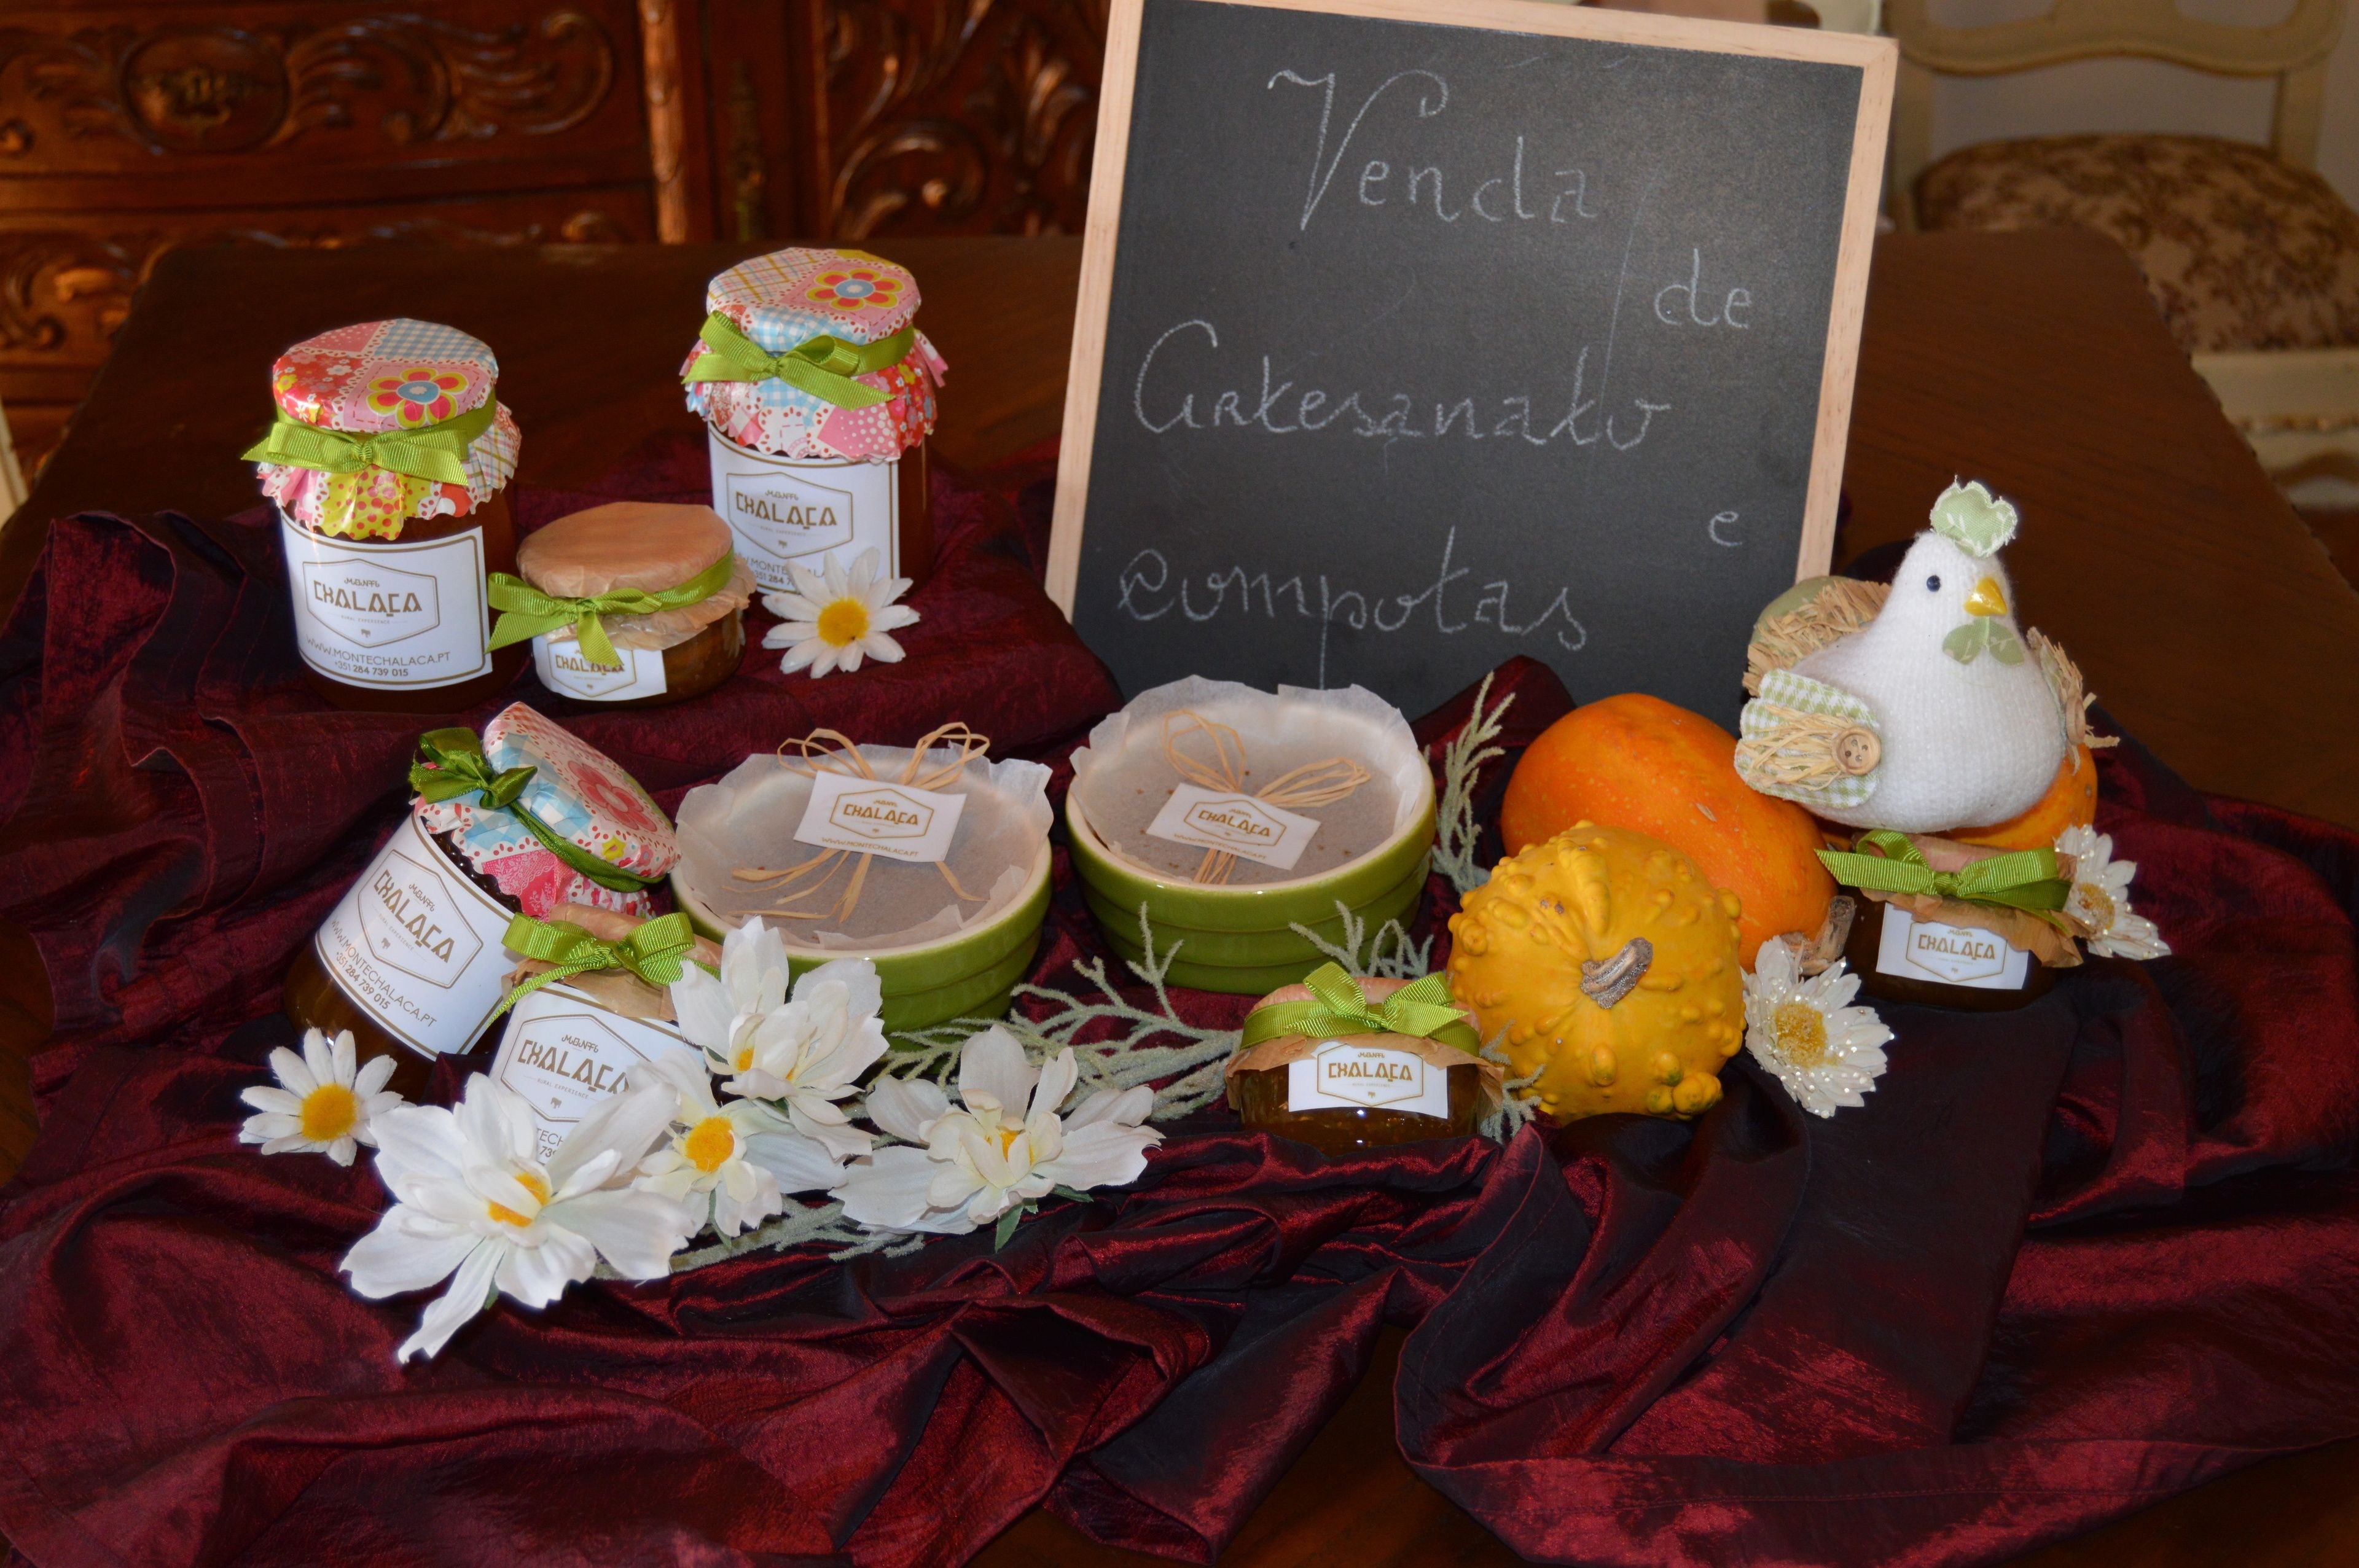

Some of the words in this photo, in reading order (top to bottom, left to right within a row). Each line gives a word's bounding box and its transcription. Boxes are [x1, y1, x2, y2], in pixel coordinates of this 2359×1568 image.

[1267, 68, 1597, 232] Venda
[1653, 247, 1753, 330] de
[754, 569, 767, 580] 351
[768, 574, 784, 584] 284
[353, 664, 370, 674] 284
[372, 667, 389, 676] 739
[391, 668, 409, 677] 015
[345, 964, 361, 982] 284
[358, 978, 375, 995] 739
[374, 993, 391, 1010] 015
[537, 1078, 553, 1088] RURAL
[554, 1083, 590, 1100] EXPERIENCE
